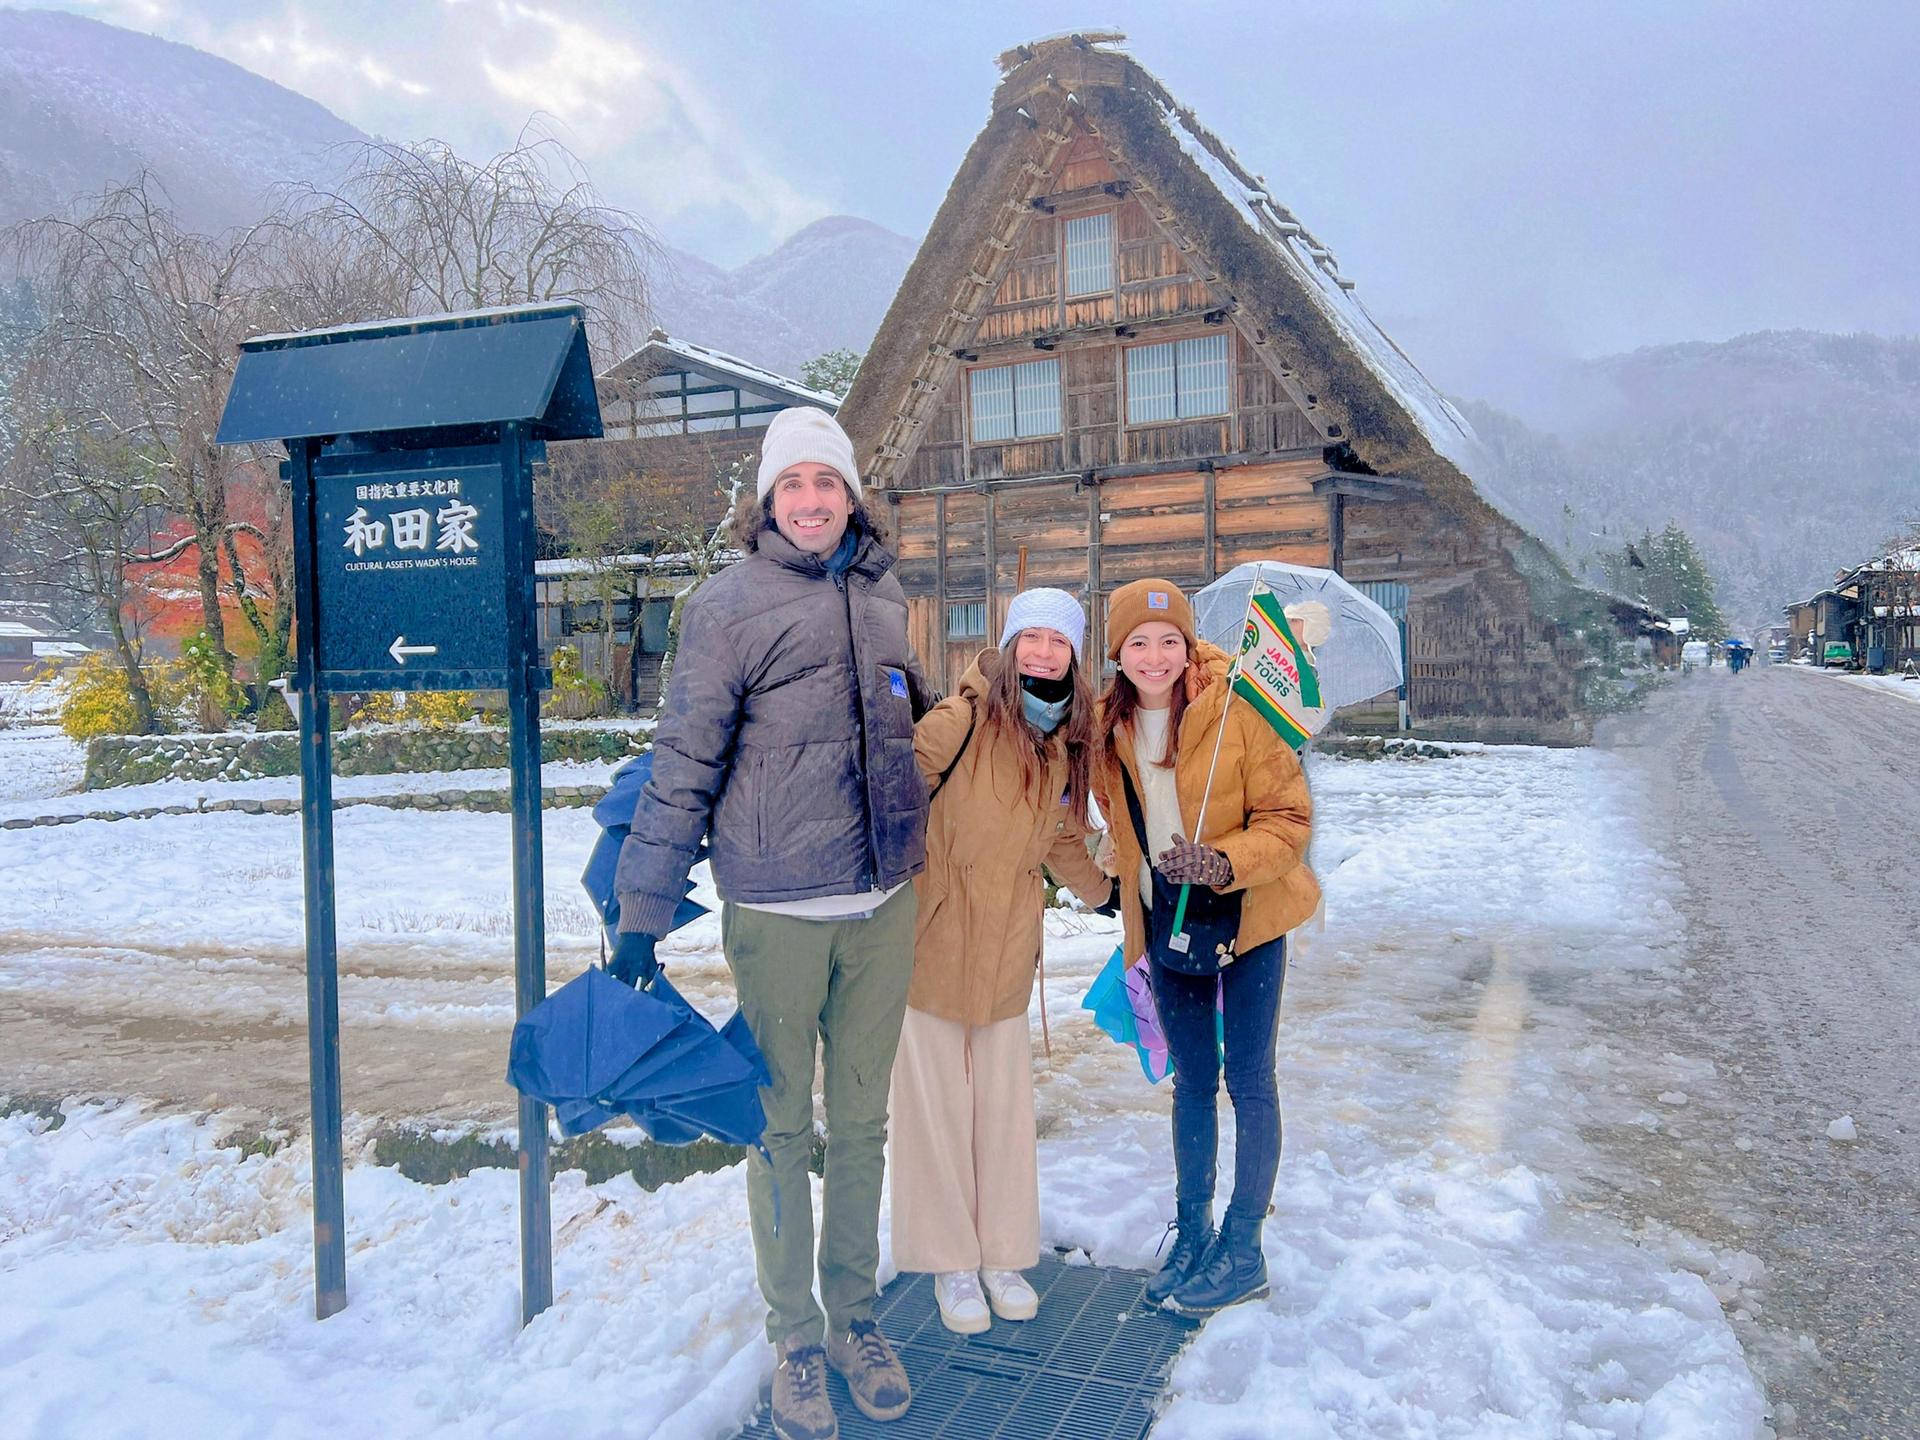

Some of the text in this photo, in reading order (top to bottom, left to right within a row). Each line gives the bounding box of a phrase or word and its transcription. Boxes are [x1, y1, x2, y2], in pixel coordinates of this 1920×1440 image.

[356, 479, 460, 500] 国指定重要文化財
[343, 499, 479, 557] 和田家
[345, 556, 478, 571] CULTURAL ASSETS WADA'S HOUSE
[1254, 660, 1290, 697] TOURS
[1266, 648, 1299, 683] JAPAN
